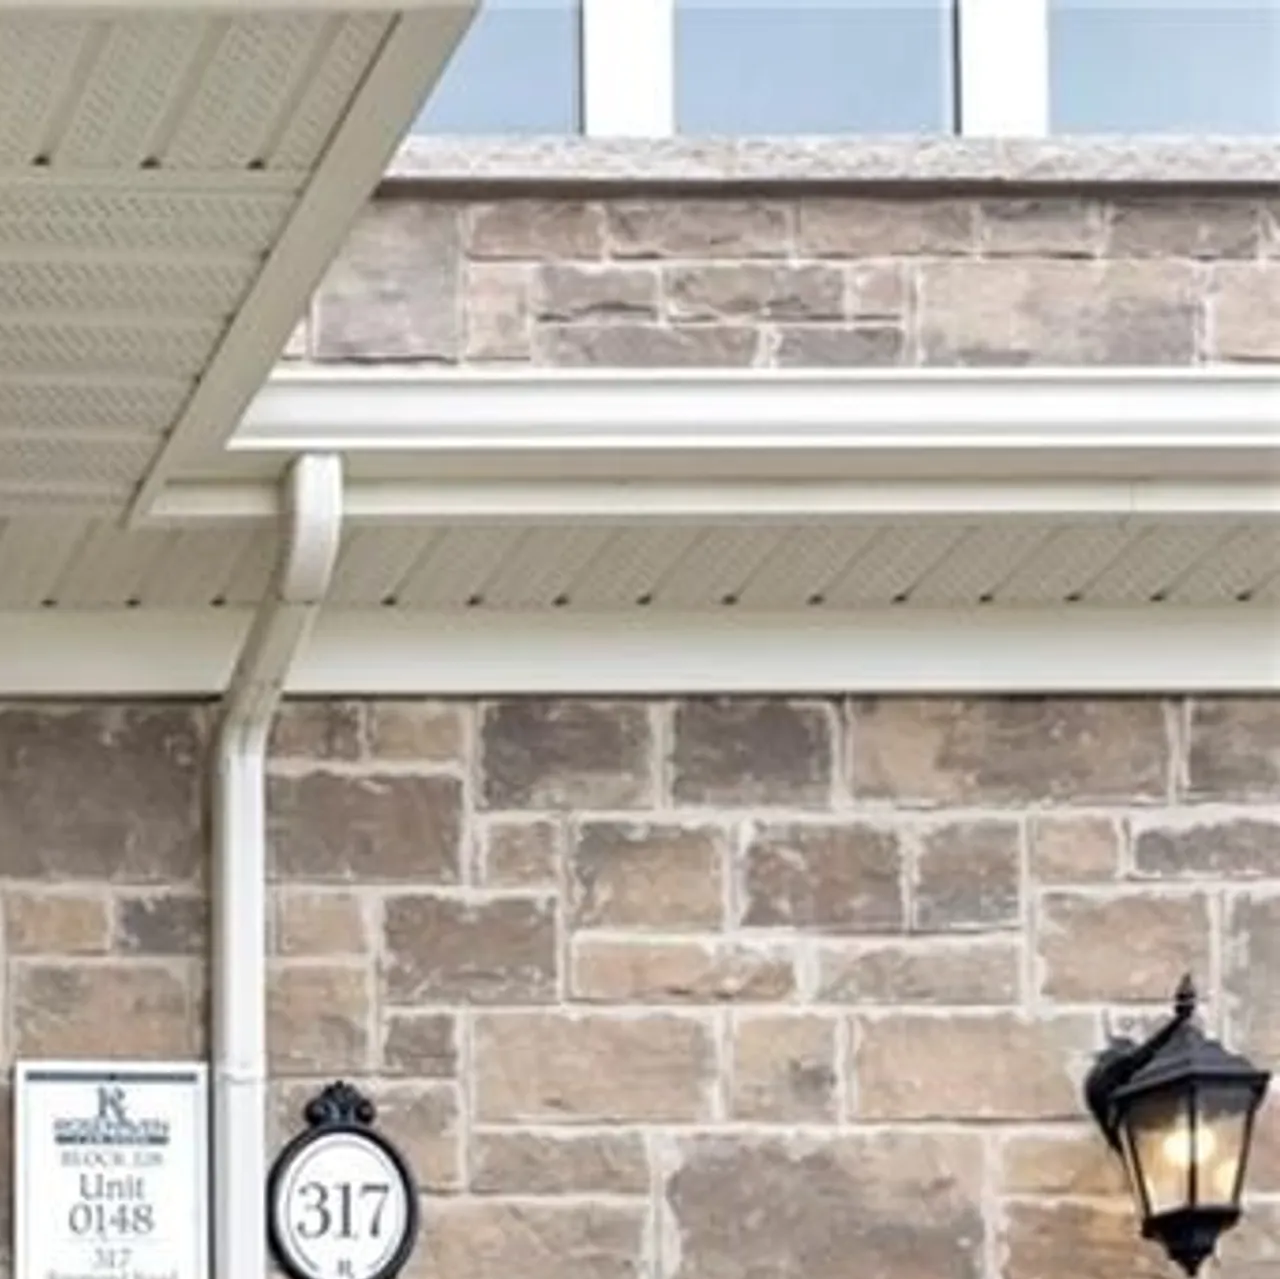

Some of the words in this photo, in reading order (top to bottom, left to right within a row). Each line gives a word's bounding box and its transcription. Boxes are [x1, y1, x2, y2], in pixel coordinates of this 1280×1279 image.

[79, 1173, 145, 1200] Unit
[68, 1204, 155, 1236] 0148
[297, 1181, 389, 1239] 317
